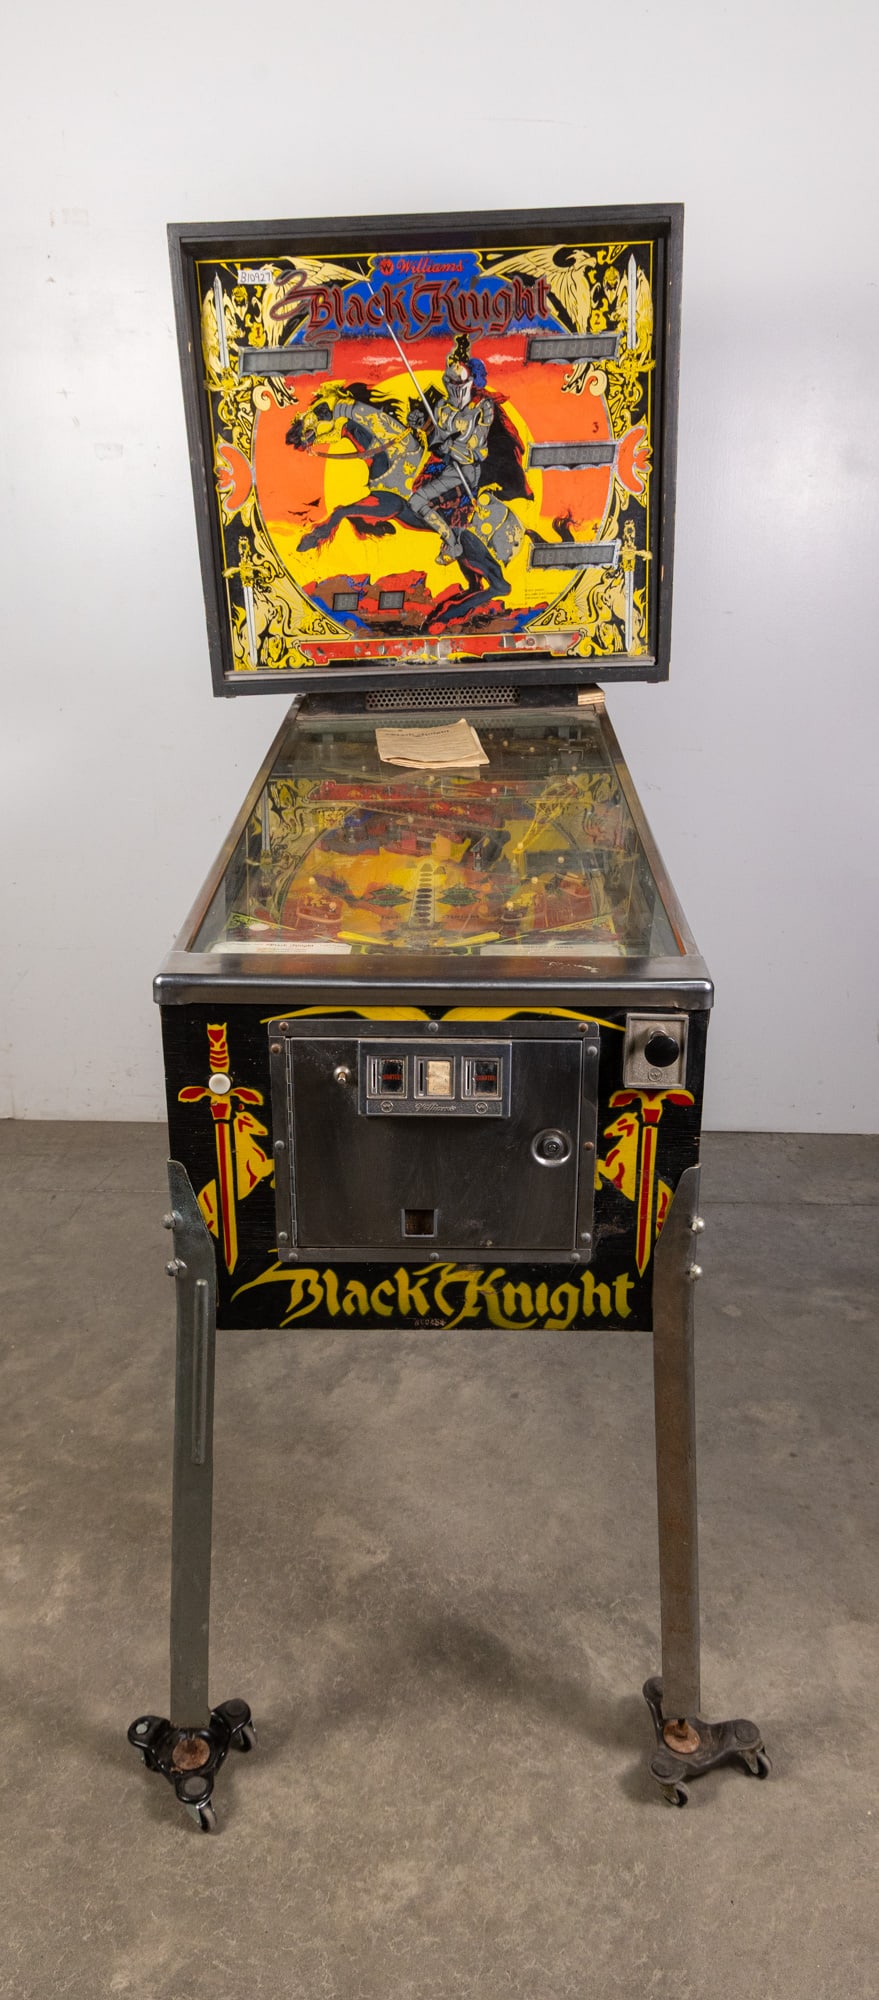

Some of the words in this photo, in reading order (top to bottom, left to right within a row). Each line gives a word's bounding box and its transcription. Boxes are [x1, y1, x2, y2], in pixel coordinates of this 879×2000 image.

[397, 257, 464, 274] Williams
[240, 271, 271, 283] B10927
[270, 270, 408, 343] Black
[400, 274, 551, 342] Knight
[594, 313, 601, 325] 2
[255, 328, 261, 339] 1
[592, 421, 599, 433] 3
[592, 523, 599, 533] 4
[231, 1260, 430, 1328] Black
[413, 1262, 635, 1330] Knight
